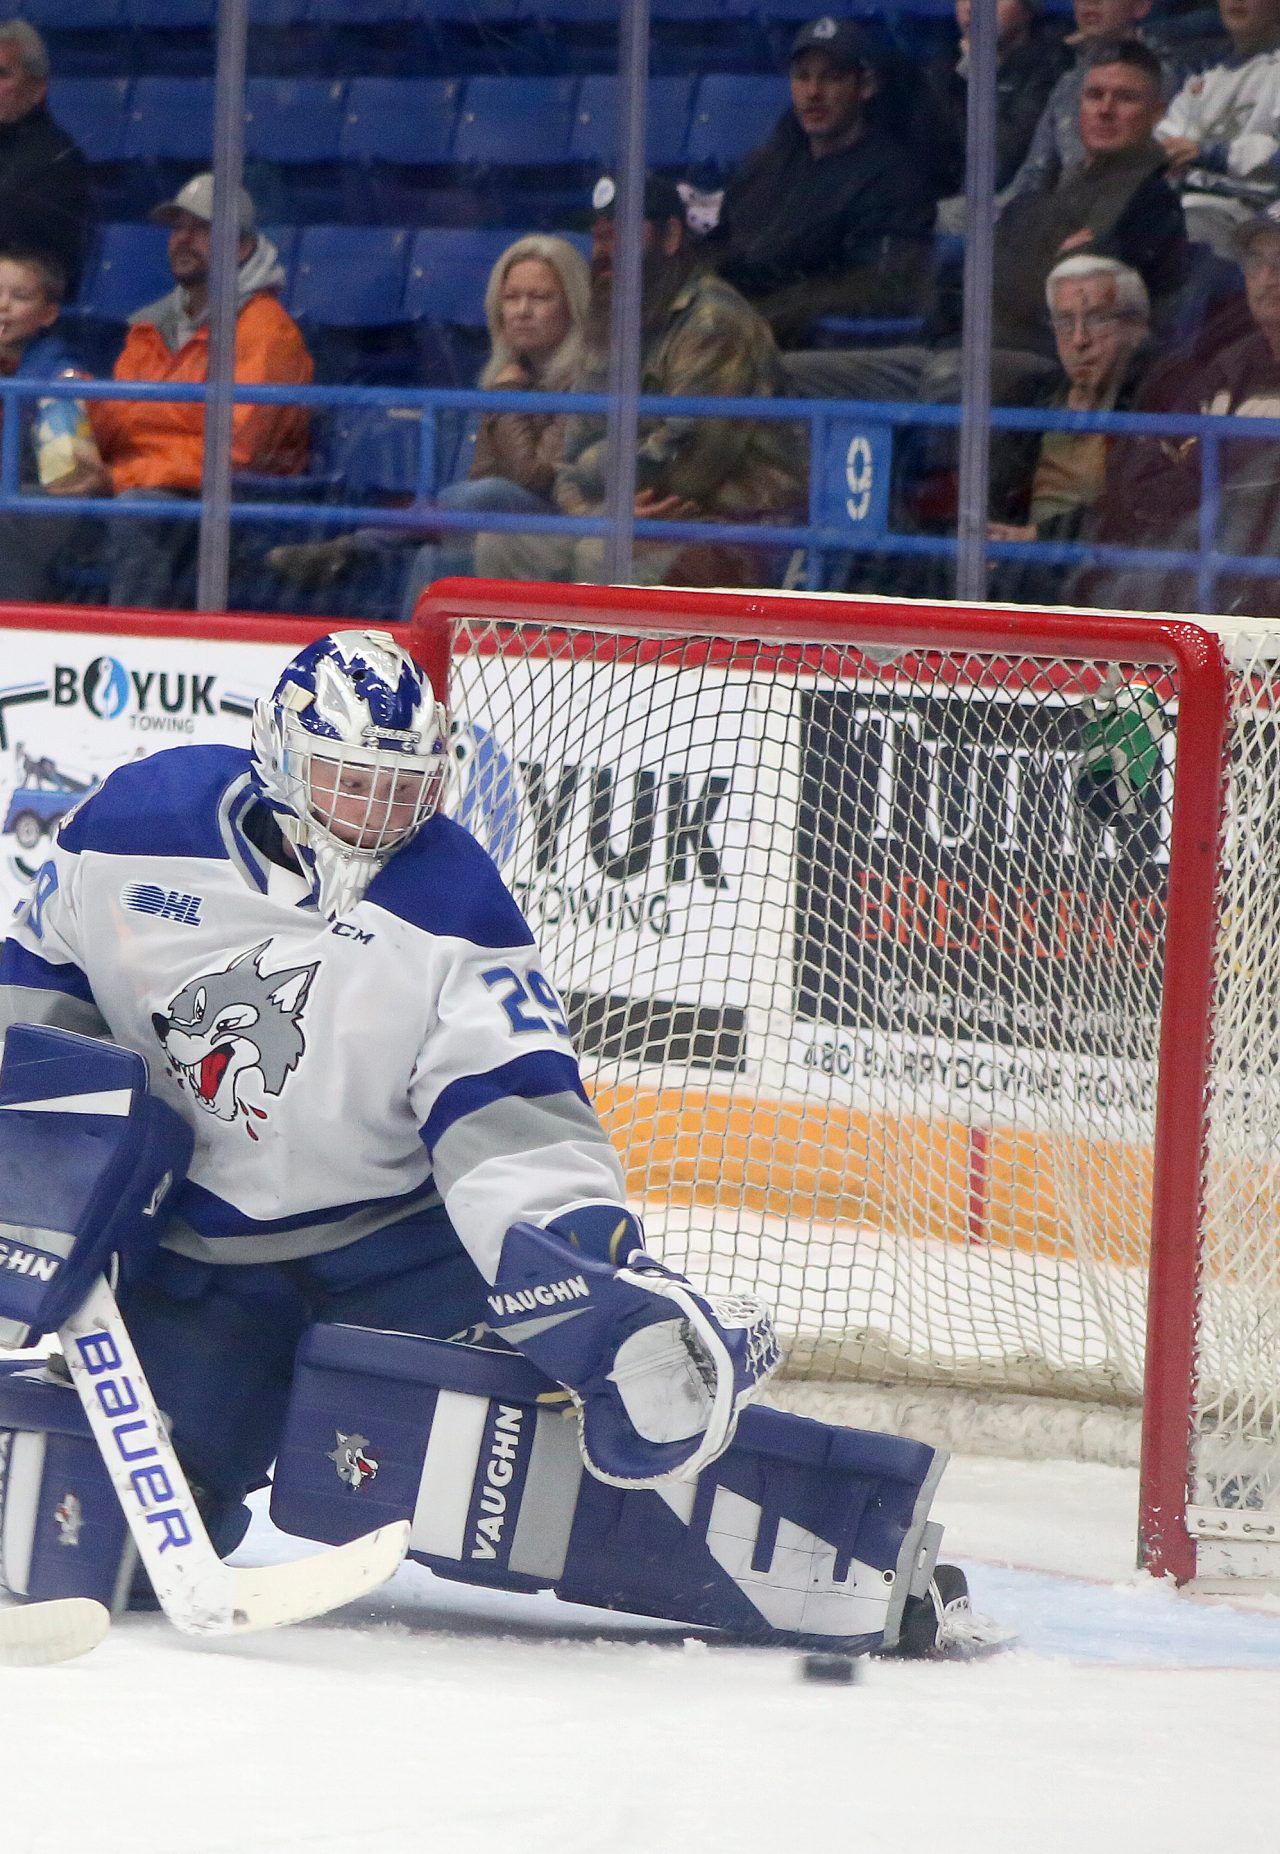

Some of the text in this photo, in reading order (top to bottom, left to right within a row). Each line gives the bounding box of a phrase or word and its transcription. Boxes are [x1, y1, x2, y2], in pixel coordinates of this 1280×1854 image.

[846, 436, 873, 521] 9
[54, 655, 218, 720] BOYUK
[129, 714, 195, 734] TOWING
[121, 881, 203, 927] OHL
[515, 882, 671, 937] TOWING
[480, 965, 569, 1038] 29
[487, 1274, 590, 1317] VAUGHN
[471, 1405, 524, 1560] VAUGHN
